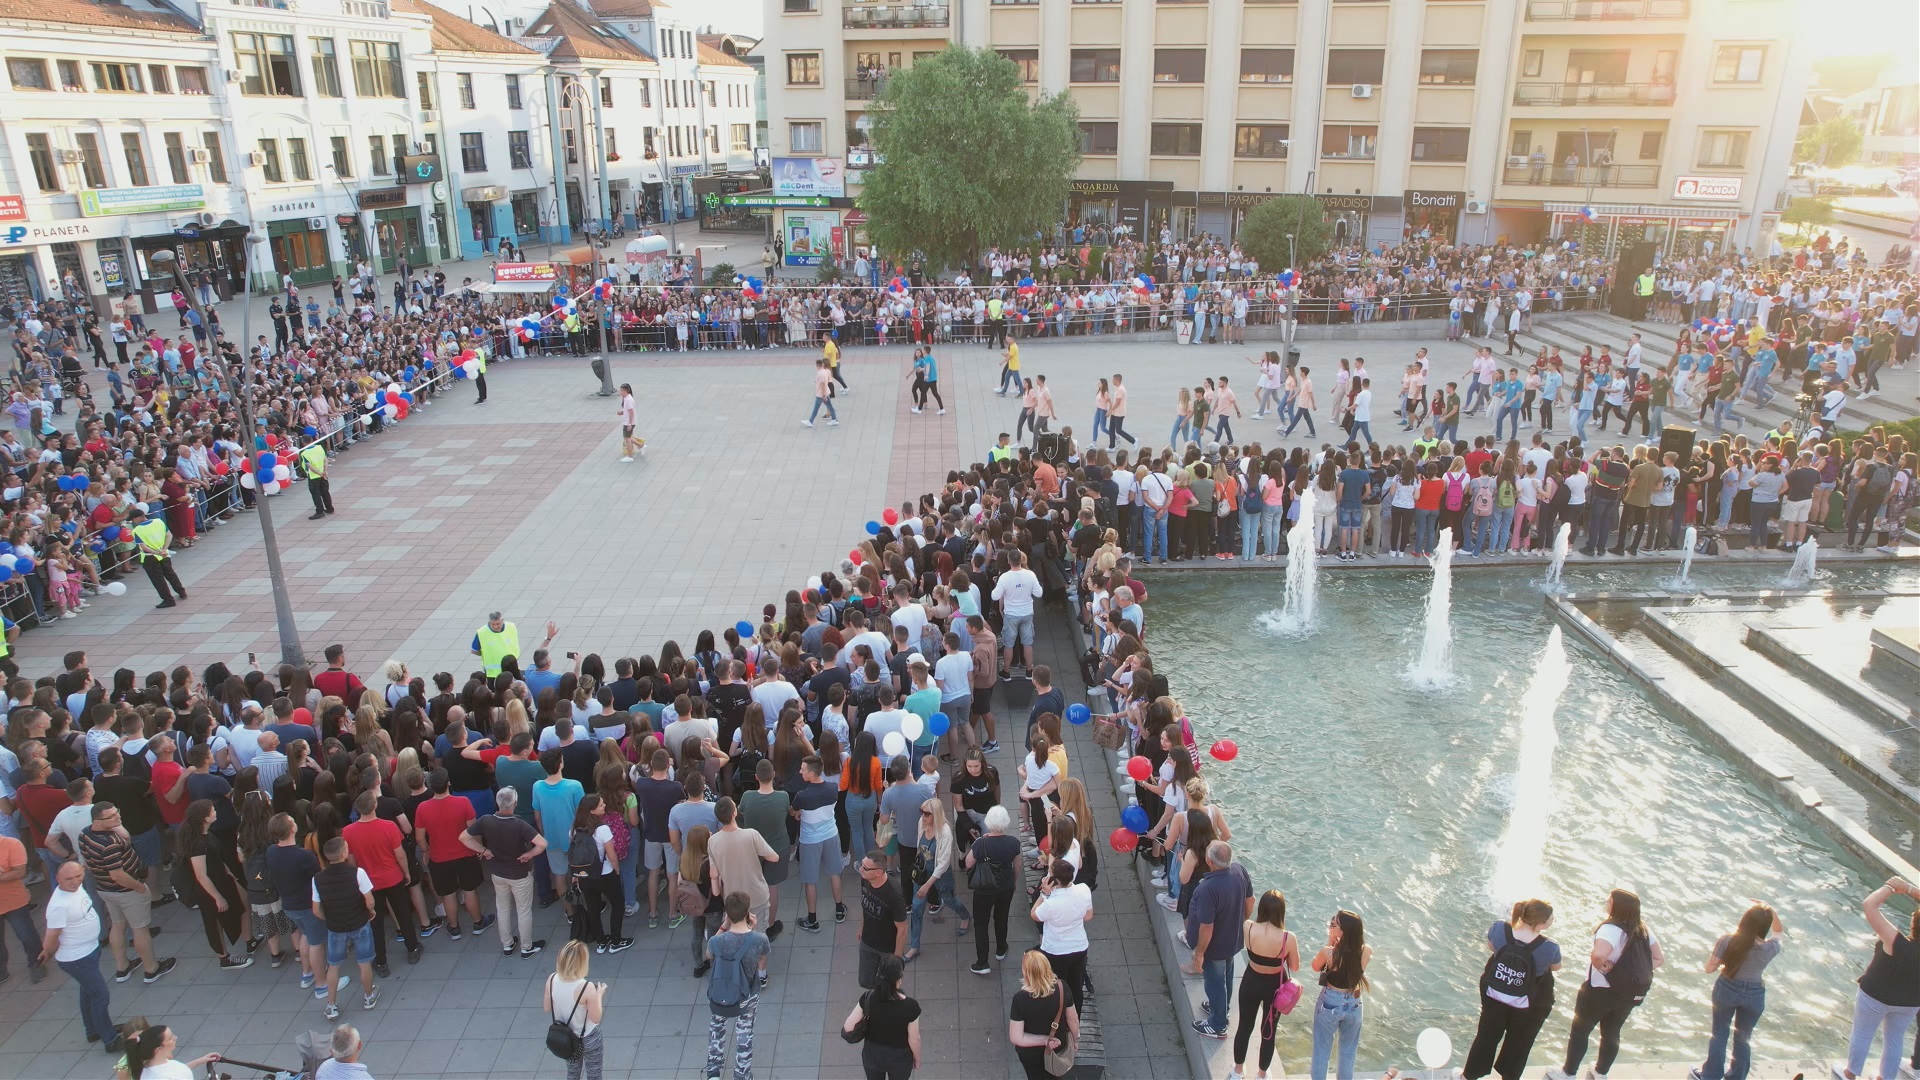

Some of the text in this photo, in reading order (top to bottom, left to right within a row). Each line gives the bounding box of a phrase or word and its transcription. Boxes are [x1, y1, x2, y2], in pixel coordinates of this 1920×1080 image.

[1700, 185, 1736, 196] PANDA
[1412, 192, 1456, 206] Bonatti
[272, 202, 316, 212] ЗЛАТАРА
[34, 225, 90, 238] PLANETA
[498, 266, 532, 276] КОКИЦЕ
[1496, 962, 1526, 978] Super
